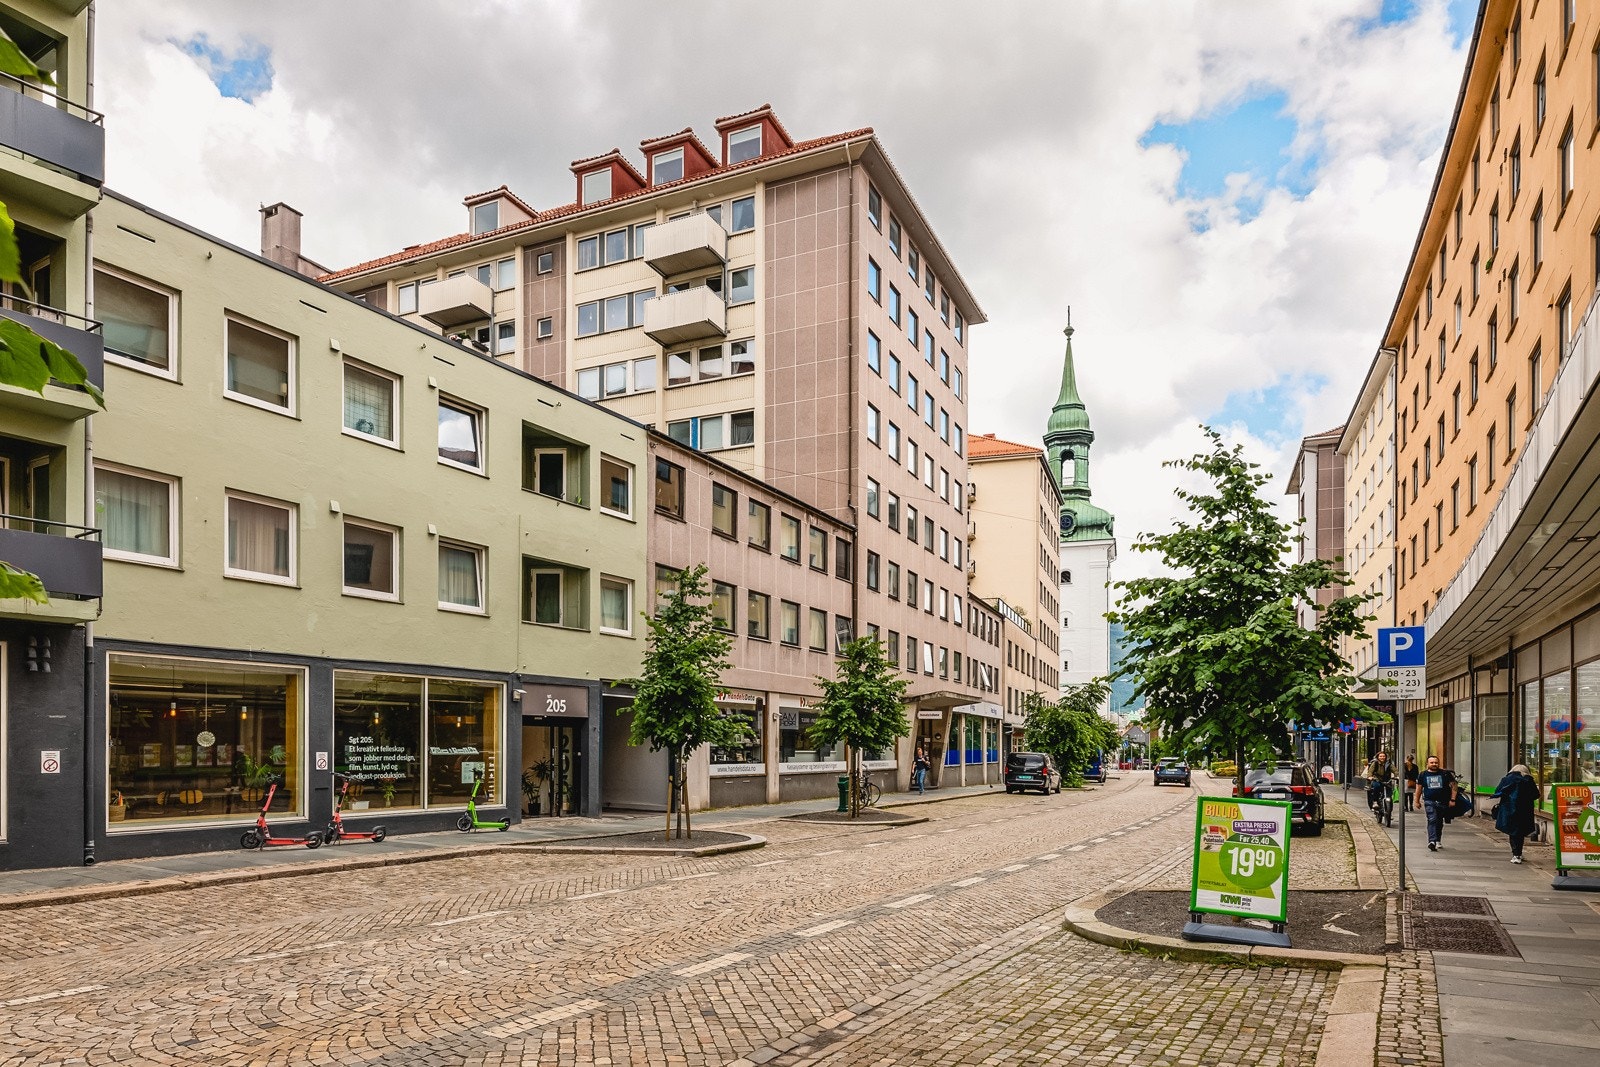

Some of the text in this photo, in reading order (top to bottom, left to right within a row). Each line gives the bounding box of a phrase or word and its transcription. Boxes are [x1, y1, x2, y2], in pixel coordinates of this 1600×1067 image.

[1389, 632, 1414, 663] P
[546, 699, 567, 713] 205
[348, 736, 374, 744] Sgt 205:
[356, 745, 380, 753] kreativt
[380, 745, 405, 754] felleskap
[363, 754, 382, 763] jobber
[396, 754, 416, 762] design,
[381, 763, 390, 771] lyd
[1560, 788, 1589, 798] BILLIG
[1205, 805, 1239, 820] BILLIG
[1234, 821, 1254, 829] EKSTRA
[1253, 822, 1275, 830] PRESSET
[1250, 836, 1270, 845] 25,40
[1220, 893, 1241, 906] KIWI
